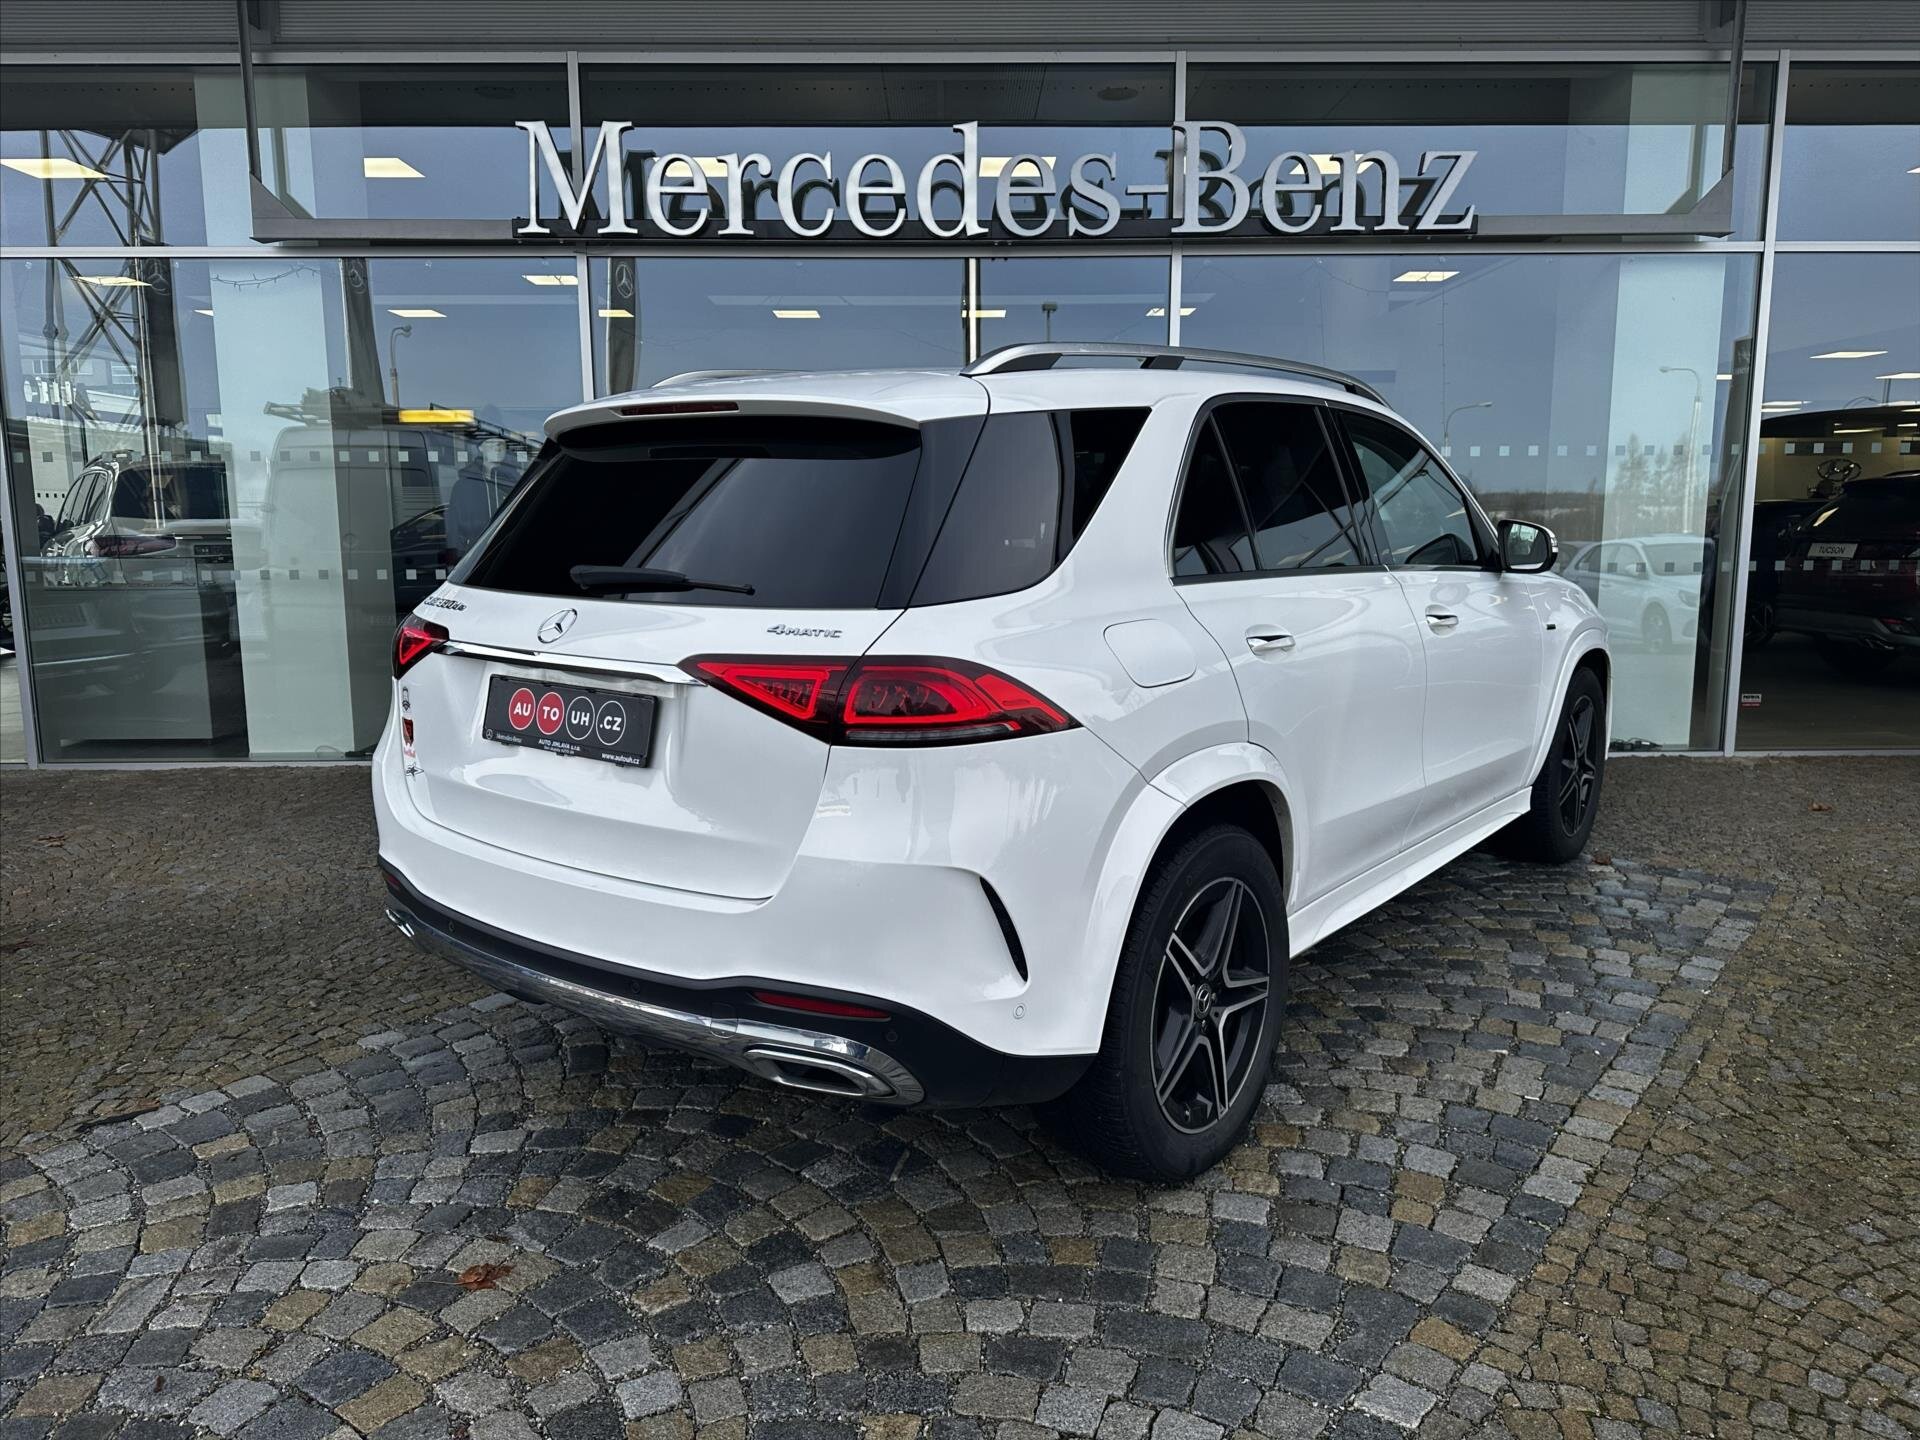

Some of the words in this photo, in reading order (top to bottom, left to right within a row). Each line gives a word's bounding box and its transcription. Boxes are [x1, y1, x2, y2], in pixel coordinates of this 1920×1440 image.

[515, 120, 1479, 238] Mercedes-Benz
[767, 623, 843, 638] 4MATIC
[513, 702, 532, 717] AU
[542, 706, 560, 721] TO
[571, 710, 590, 726] UH
[600, 716, 622, 731] .CZ
[538, 739, 552, 747] AUTO
[601, 752, 641, 765] www.autouh.cz
